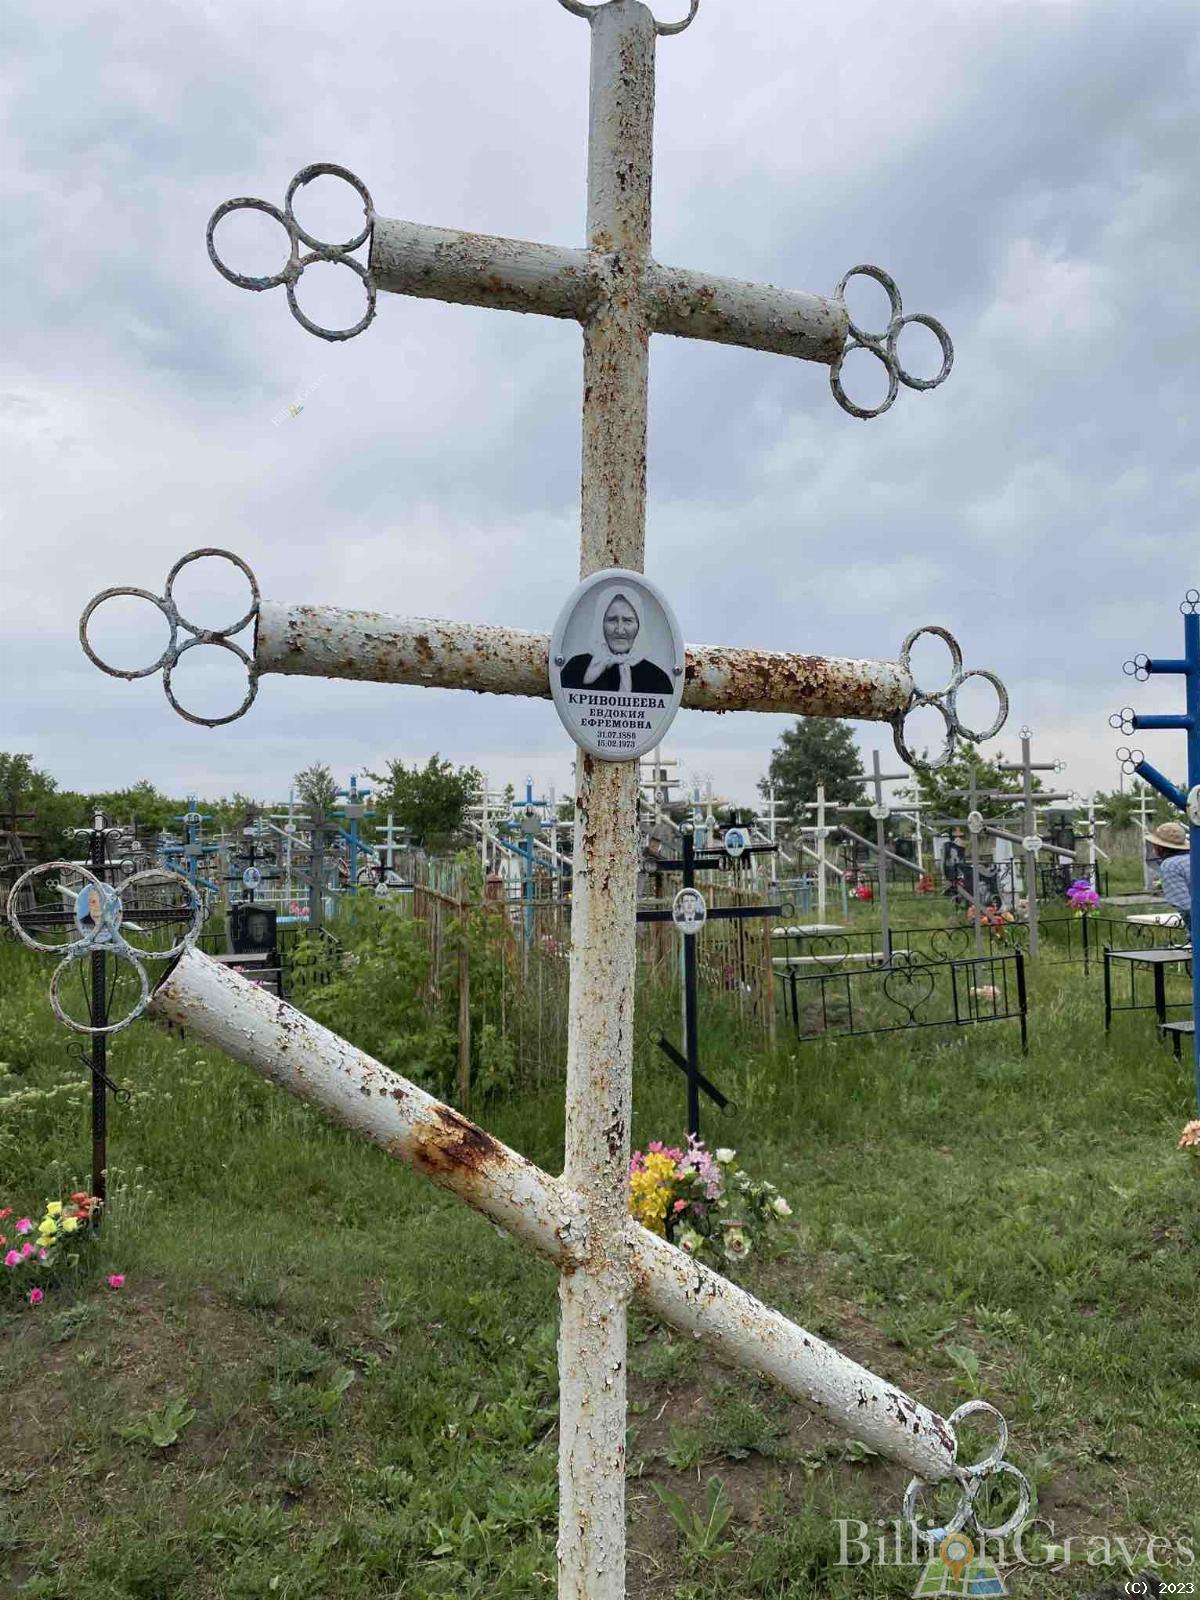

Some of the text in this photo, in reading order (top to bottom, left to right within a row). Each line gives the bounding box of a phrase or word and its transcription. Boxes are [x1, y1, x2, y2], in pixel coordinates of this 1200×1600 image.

[568, 693, 666, 709] КРИВОШЕЕВА
[589, 708, 645, 719] ЕВДОКИЯ
[580, 718, 652, 730] ЕФРЕМОВНА
[597, 739, 636, 748] 15.02.1973
